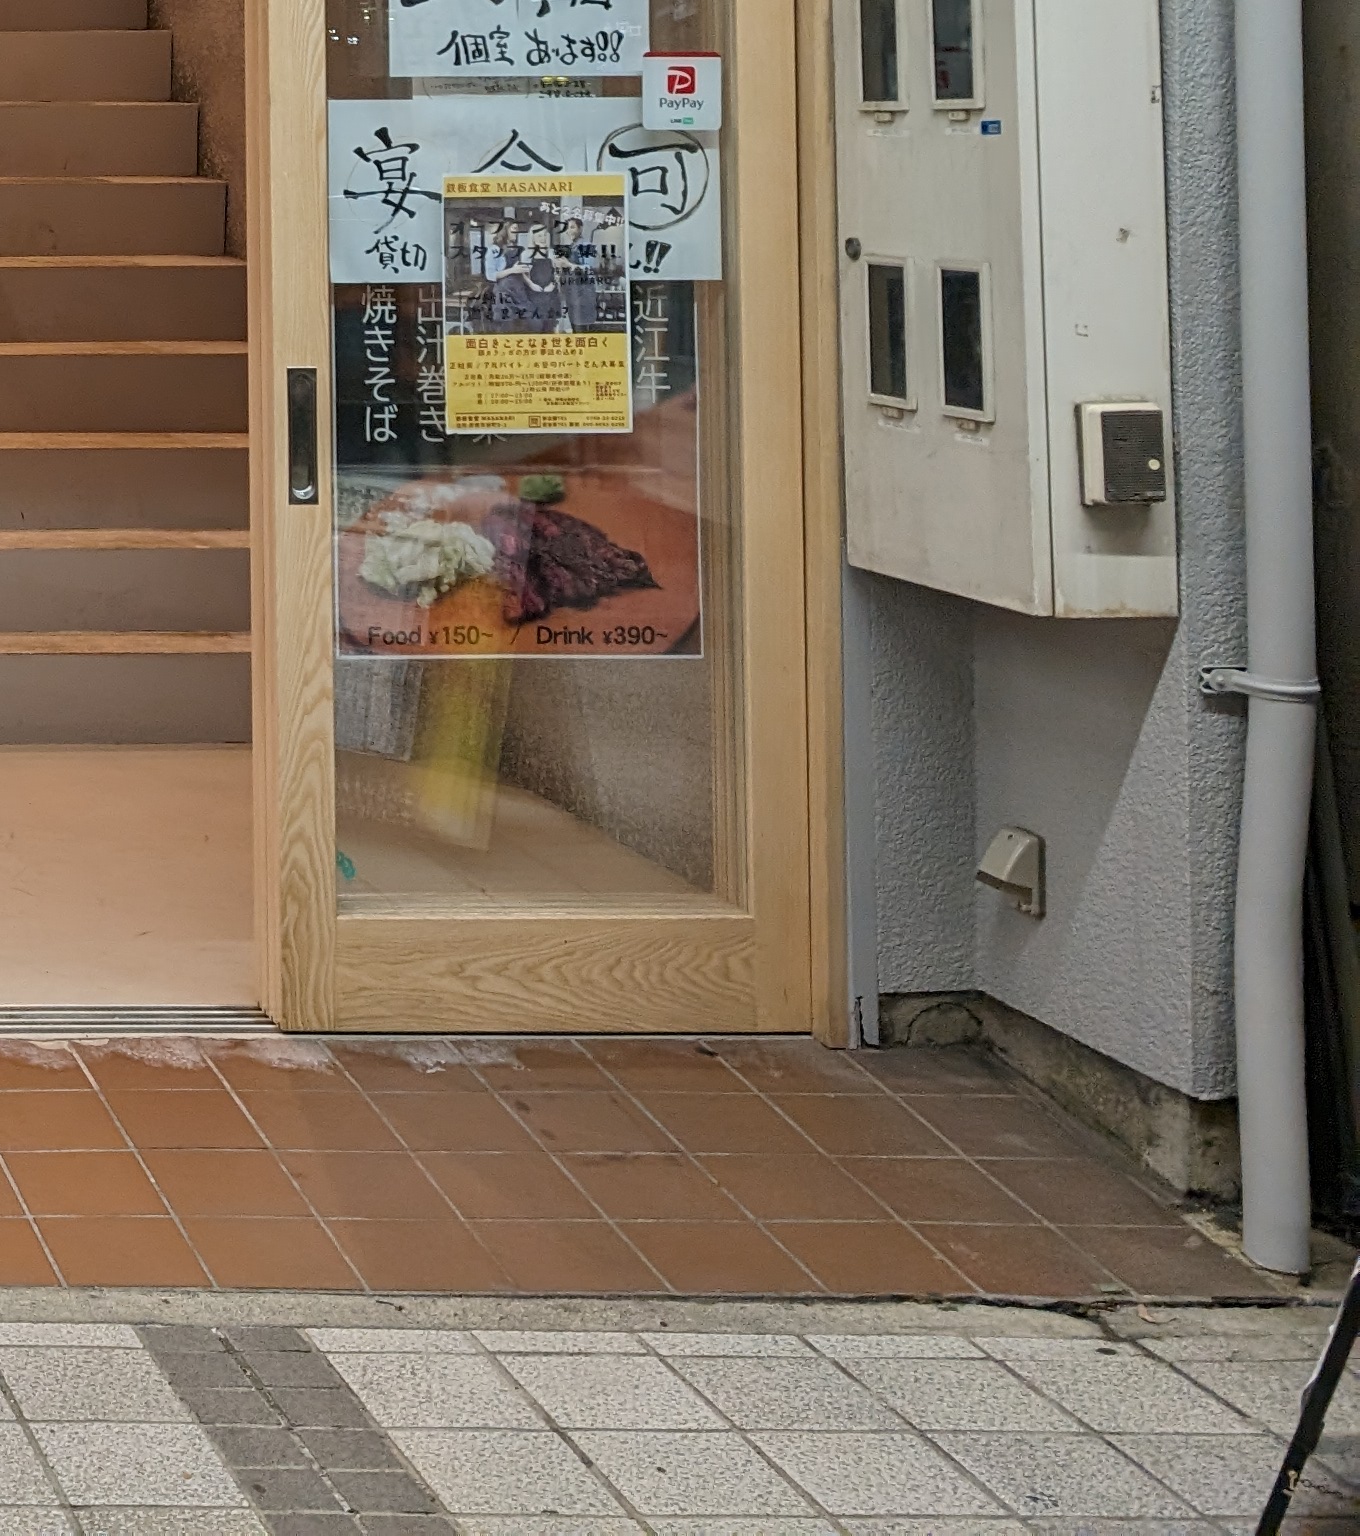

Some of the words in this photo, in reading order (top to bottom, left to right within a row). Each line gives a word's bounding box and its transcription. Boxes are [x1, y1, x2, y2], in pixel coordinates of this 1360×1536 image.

[659, 97, 704, 110] PayPay
[446, 182, 492, 194] 鉄板食堂
[496, 181, 573, 193] MASANARI
[633, 284, 671, 405] 近江牛
[361, 284, 399, 444] 焼きそば
[368, 626, 422, 647] Food
[429, 626, 494, 647] ¥150~
[536, 625, 594, 647] Drink
[602, 625, 669, 647] ¥390~
